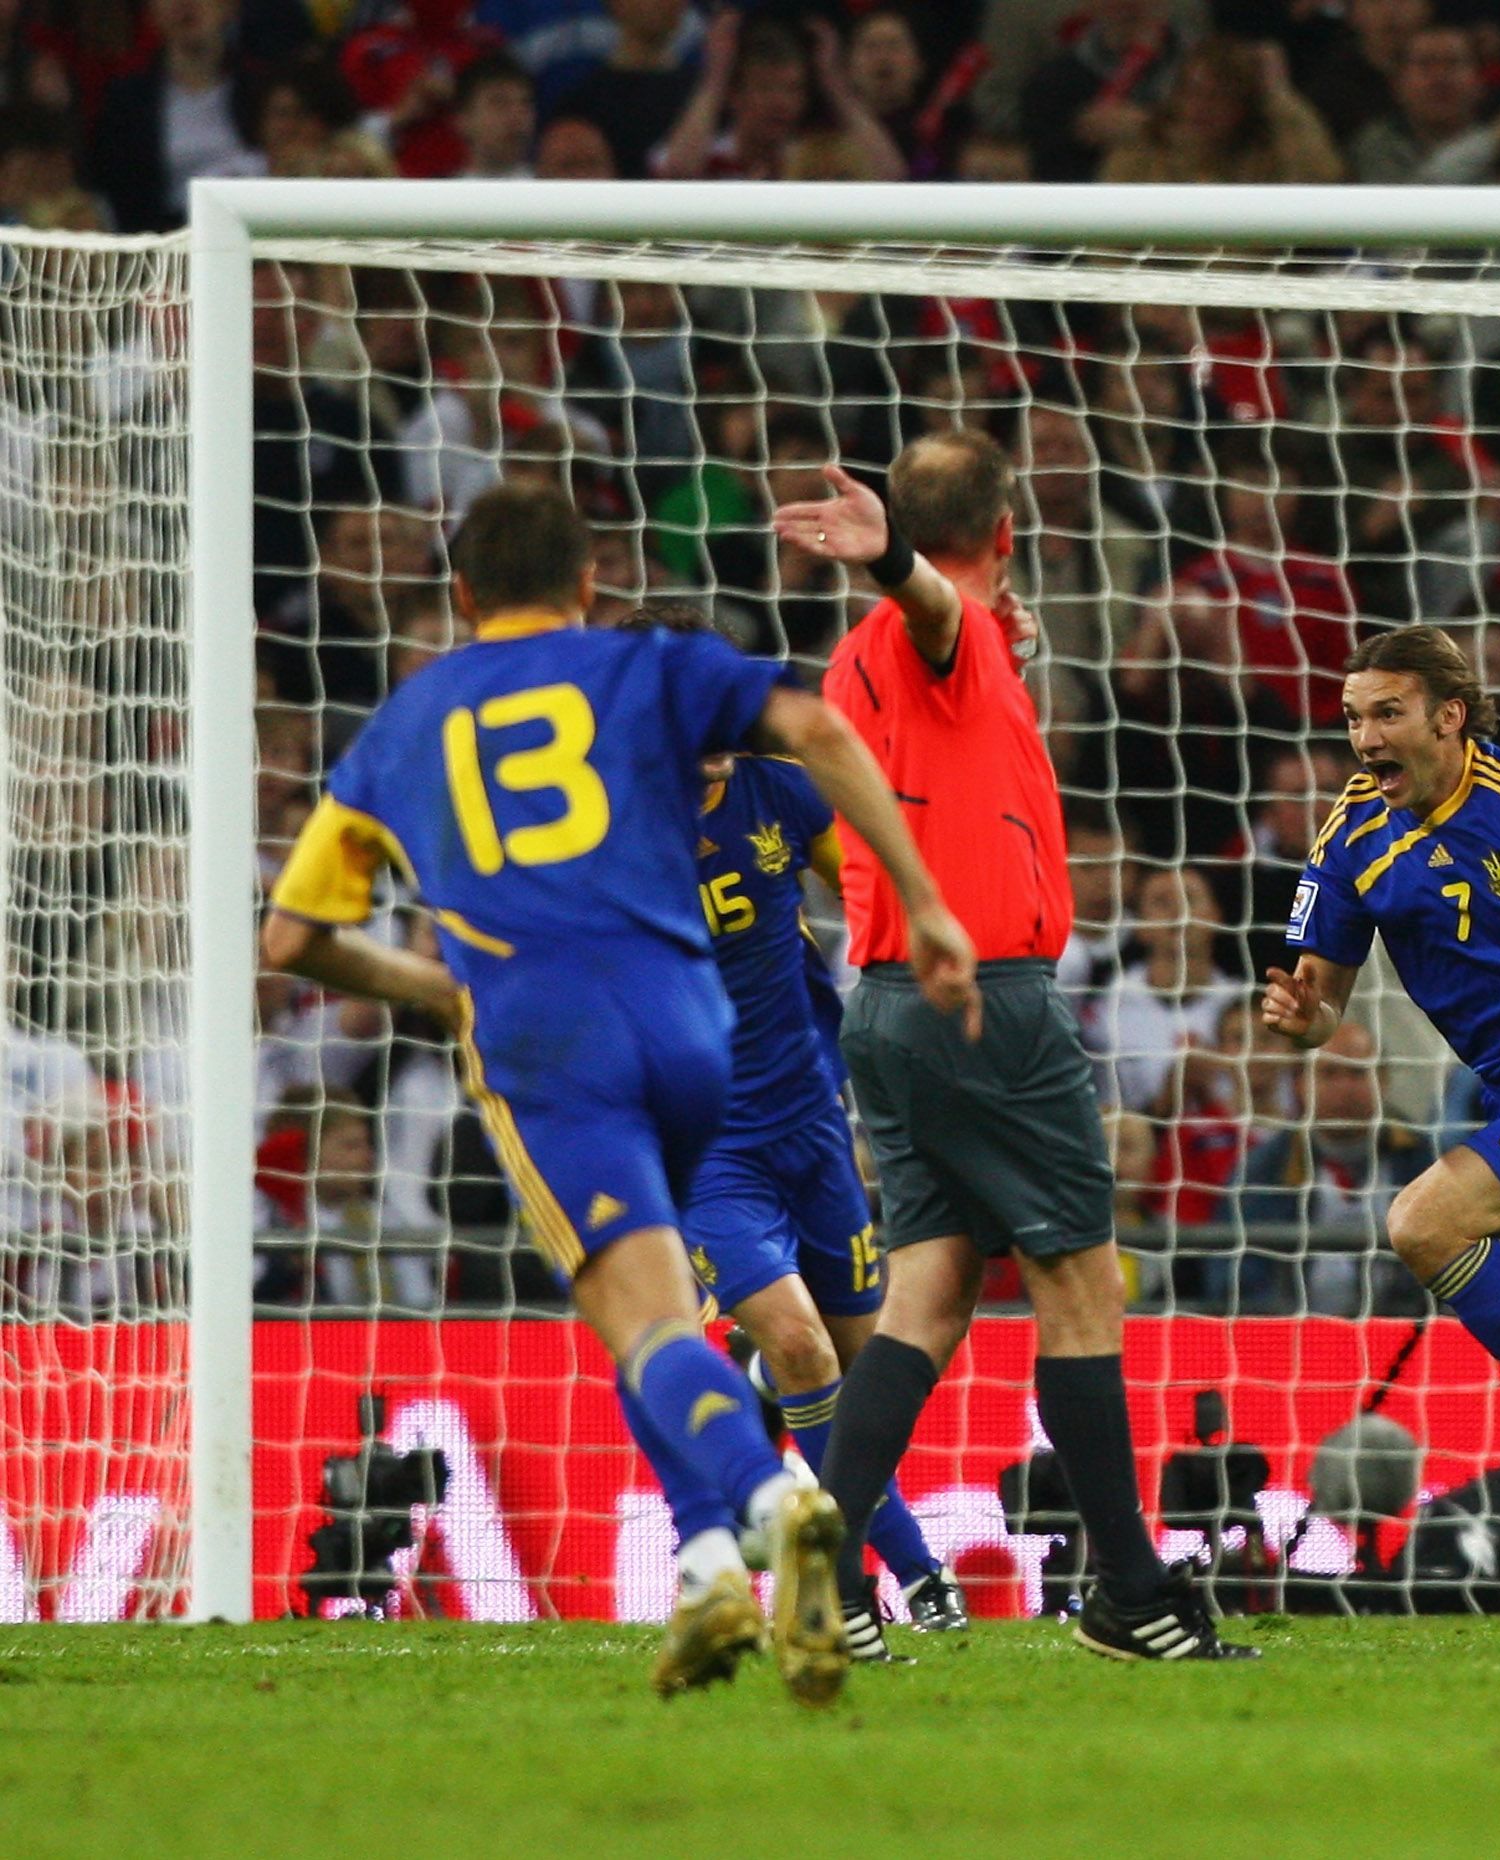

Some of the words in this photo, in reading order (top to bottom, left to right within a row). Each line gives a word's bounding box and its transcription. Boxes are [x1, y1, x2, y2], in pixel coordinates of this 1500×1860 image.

[442, 682, 611, 876] 13
[698, 871, 756, 937] 15
[1441, 881, 1472, 942] 7
